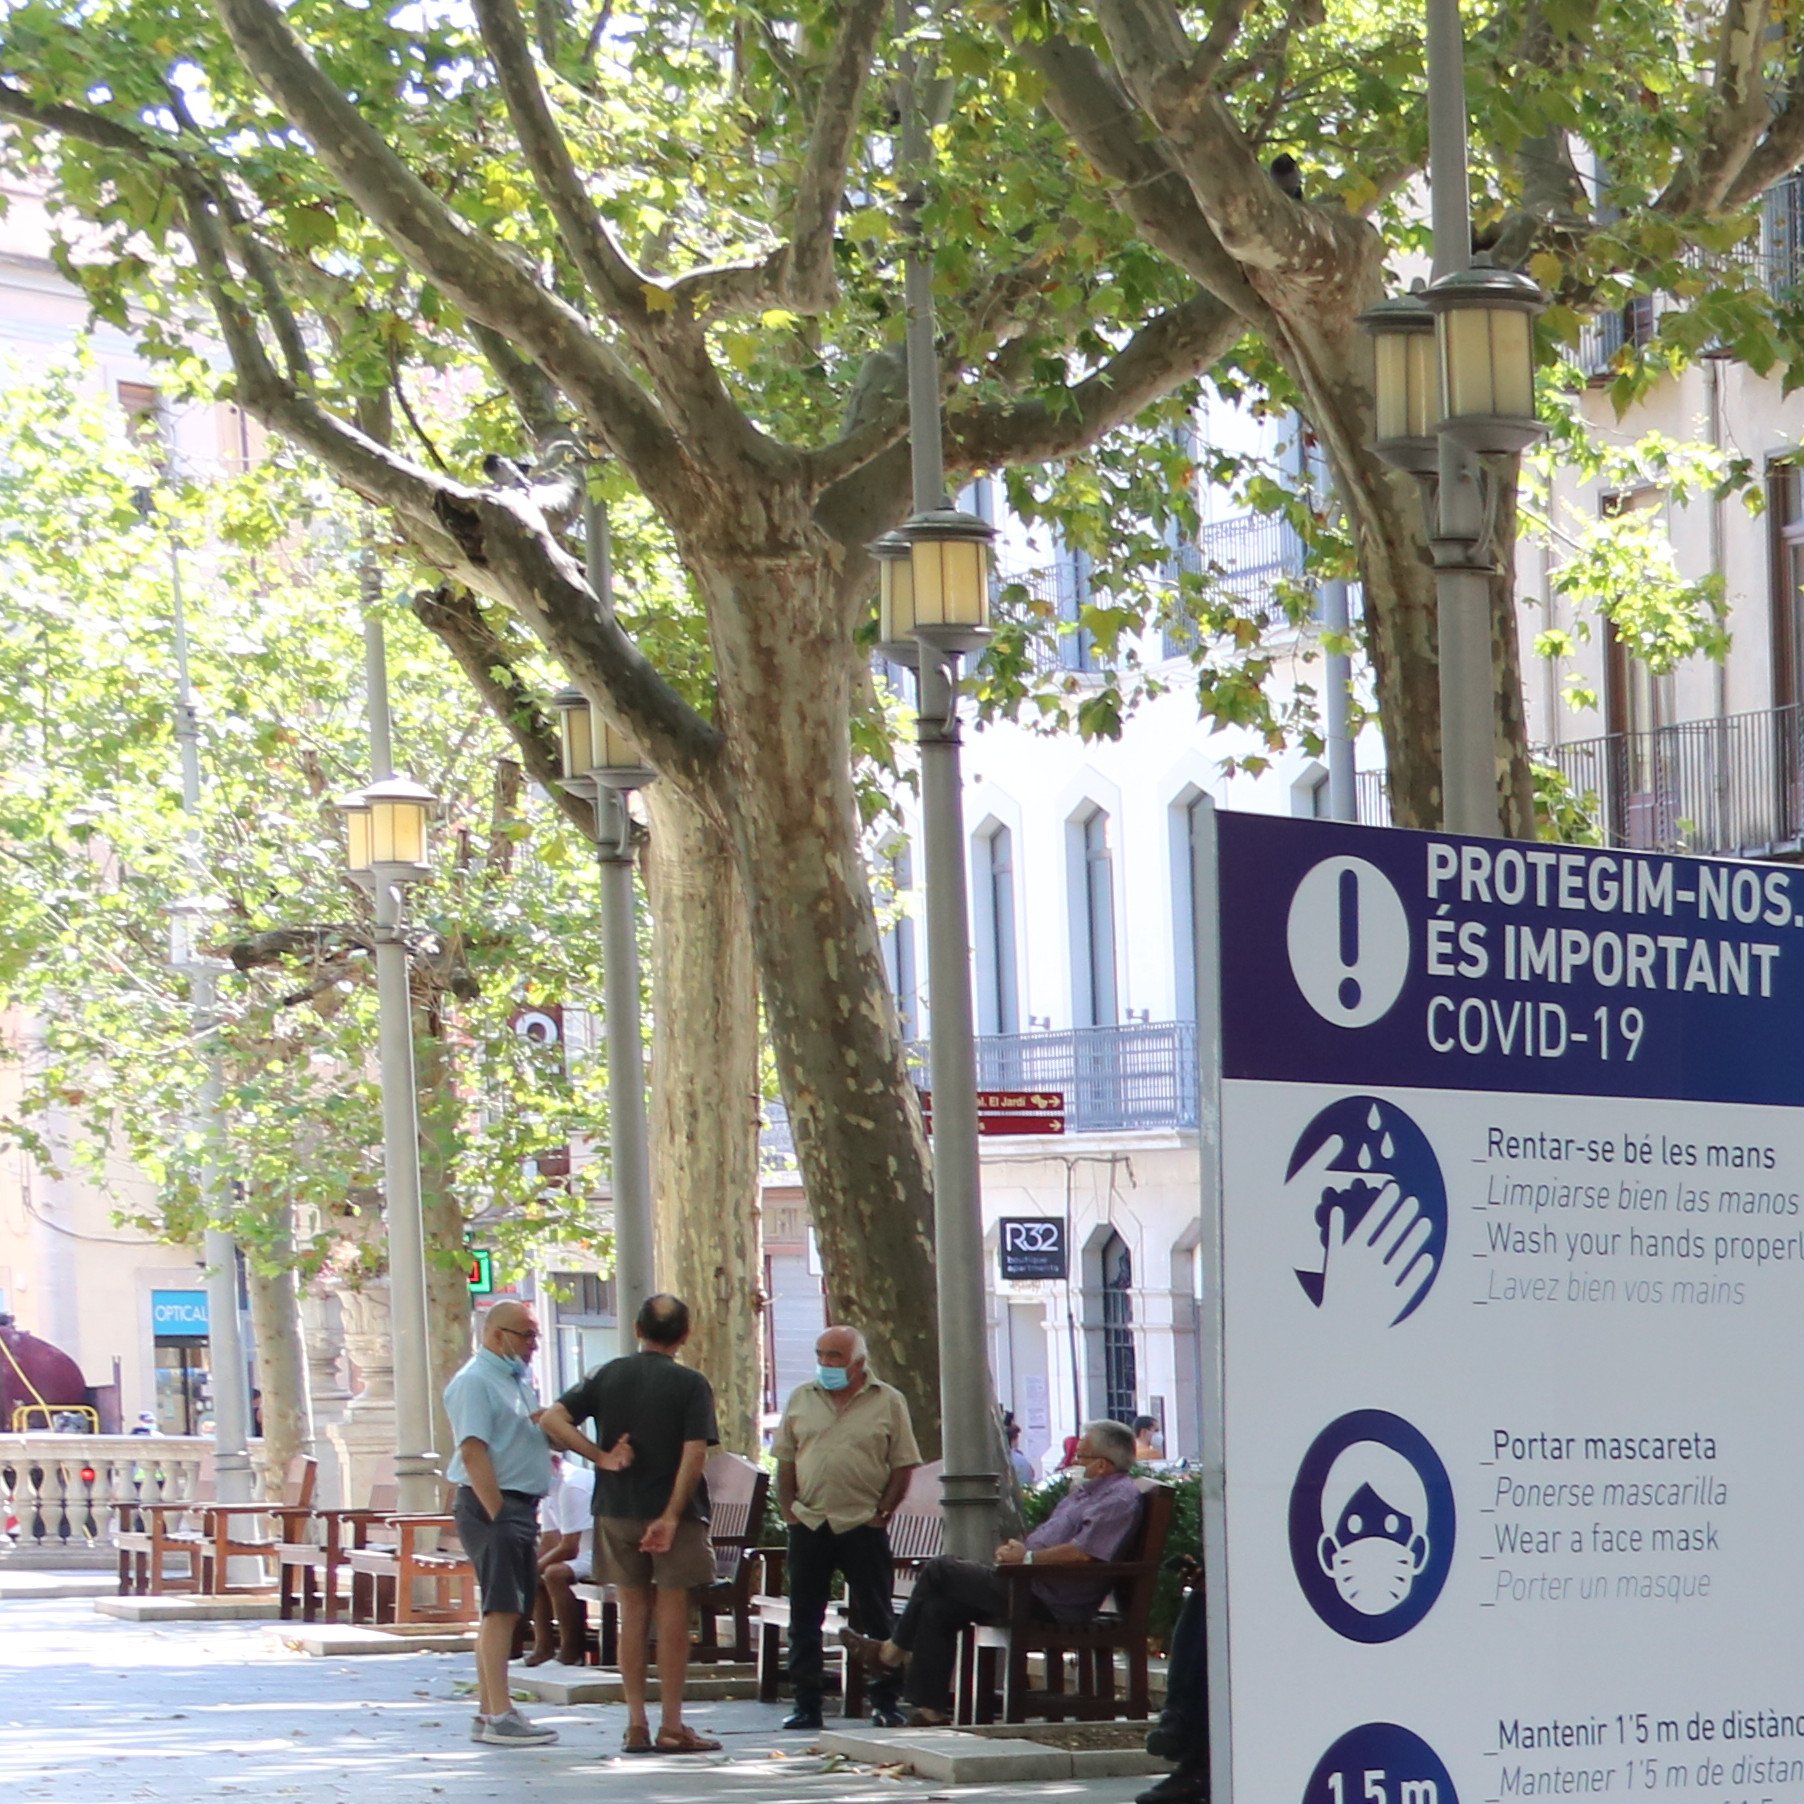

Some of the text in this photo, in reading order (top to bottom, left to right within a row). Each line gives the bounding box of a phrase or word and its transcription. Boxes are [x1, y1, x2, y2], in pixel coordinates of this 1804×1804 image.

[1427, 843, 1804, 929] PROTEGIM-NOS.
[1427, 903, 1780, 998] ÉS IMPORTANT
[1427, 995, 1644, 1062] COVID-19
[1624, 1133, 1653, 1165] bé
[1662, 1135, 1697, 1167] les
[1707, 1145, 1776, 1170] mans
[1618, 1180, 1668, 1211] bien
[1676, 1182, 1710, 1213] las
[1718, 1191, 1800, 1216] manos
[1005, 1222, 1059, 1252] R32
[1565, 1232, 1622, 1262] your
[1630, 1226, 1705, 1259] hands
[1567, 1271, 1616, 1303] bien
[1624, 1280, 1664, 1304] vos
[1672, 1274, 1745, 1306] mains
[1584, 1432, 1716, 1460] mascareta
[1602, 1476, 1727, 1507] mascarilla
[1570, 1530, 1583, 1554] a
[1591, 1522, 1643, 1553] face
[1652, 1521, 1719, 1552] mask
[1580, 1576, 1608, 1600] un
[1616, 1574, 1711, 1604] masque
[1616, 1713, 1649, 1744] 1'5
[1657, 1720, 1679, 1742] m
[1686, 1712, 1715, 1742] de
[1626, 1758, 1658, 1790] 1'5
[1666, 1765, 1688, 1787] m
[1696, 1757, 1724, 1787] de
